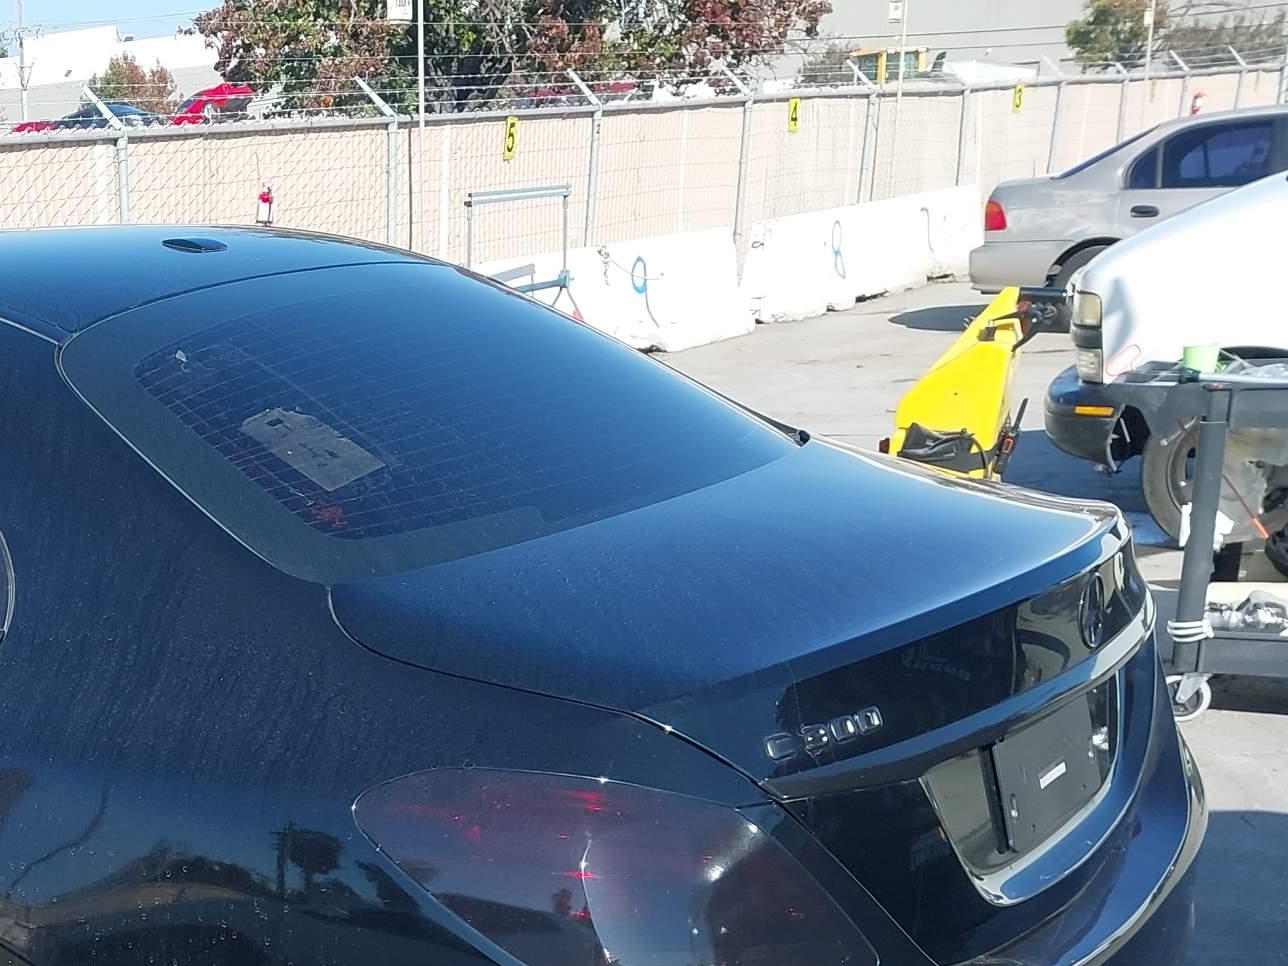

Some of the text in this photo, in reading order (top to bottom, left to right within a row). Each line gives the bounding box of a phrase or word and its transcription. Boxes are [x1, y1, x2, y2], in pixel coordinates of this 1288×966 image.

[1014, 87, 1023, 109] 3
[790, 101, 798, 127] 4
[506, 122, 516, 153] 5
